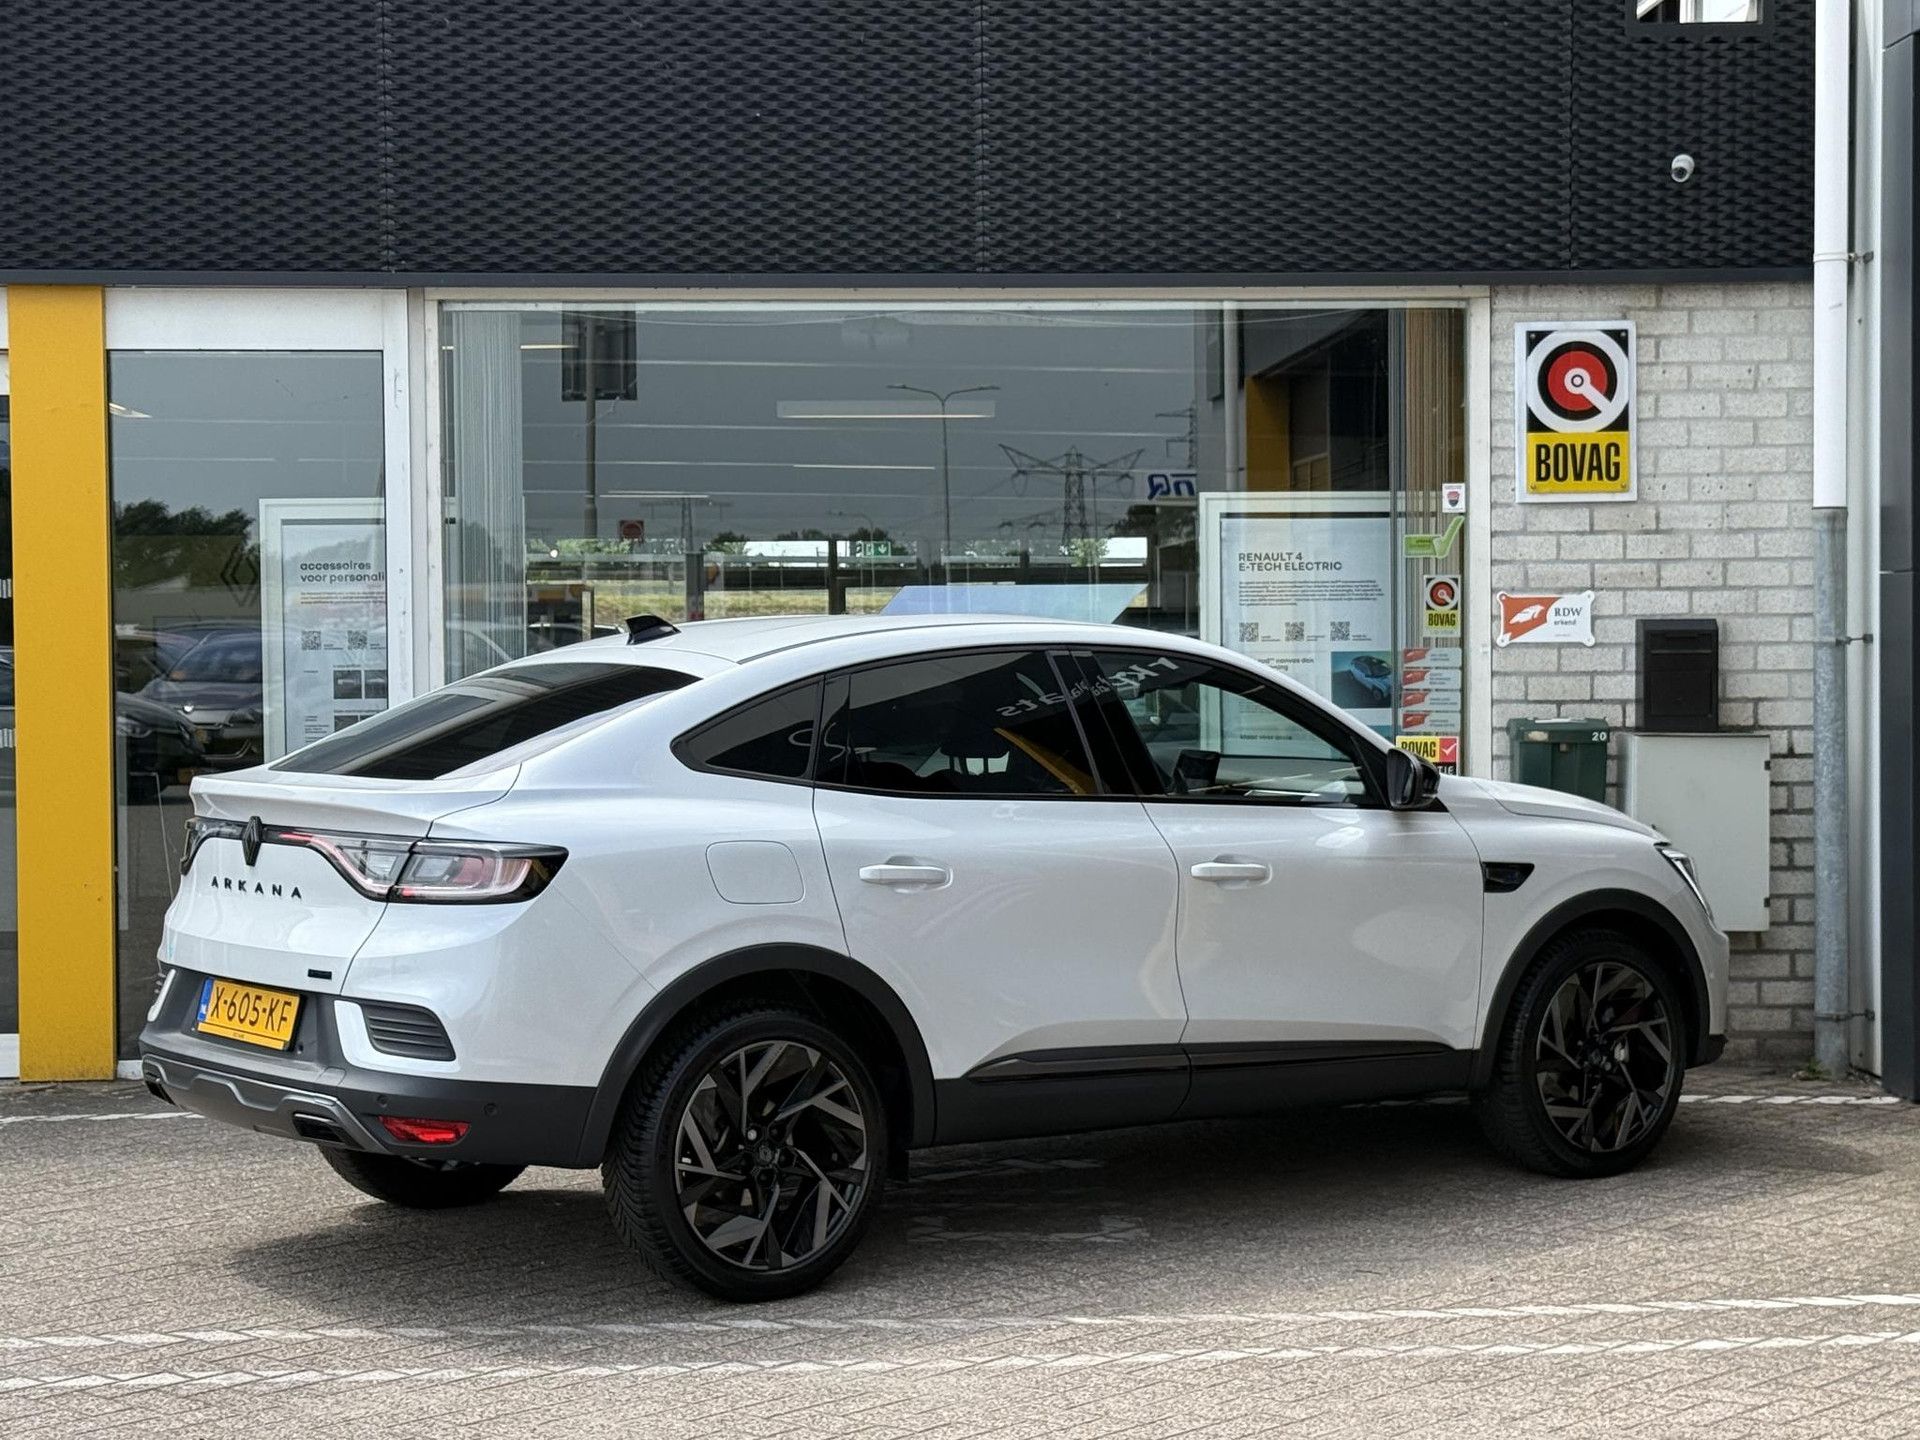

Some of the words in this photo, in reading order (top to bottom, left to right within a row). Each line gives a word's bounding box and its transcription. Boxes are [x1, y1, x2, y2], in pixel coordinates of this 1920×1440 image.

[1536, 442, 1620, 482] BOVAG
[1239, 552, 1293, 561] RENAULT
[1295, 552, 1303, 561] 4
[300, 560, 371, 571] accessoires
[1239, 562, 1281, 572] E-TECH
[1284, 561, 1342, 571] ELECTRIC
[300, 573, 327, 583] voor
[1554, 607, 1582, 617] RDW
[1427, 613, 1456, 626] BOVAG
[1591, 731, 1608, 742] 20
[211, 875, 302, 899] ARKANA
[210, 986, 292, 1032] X-605-KF
